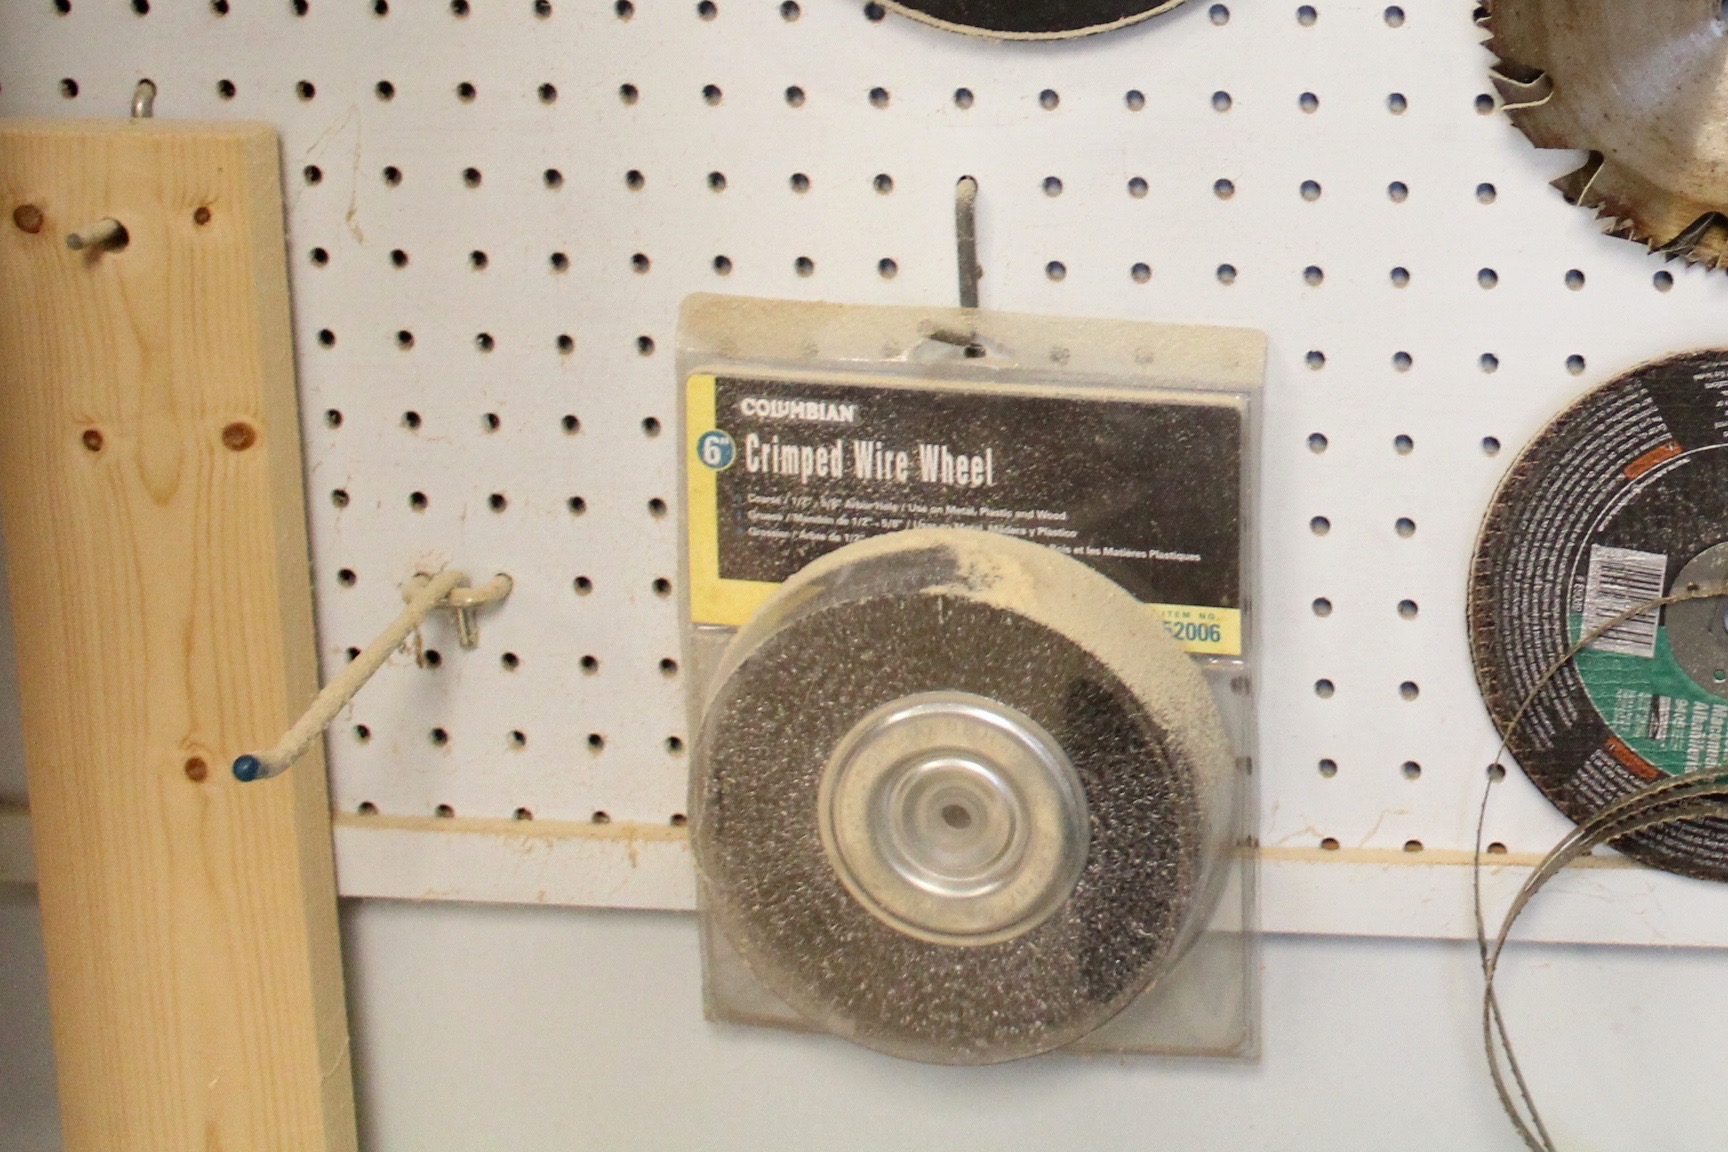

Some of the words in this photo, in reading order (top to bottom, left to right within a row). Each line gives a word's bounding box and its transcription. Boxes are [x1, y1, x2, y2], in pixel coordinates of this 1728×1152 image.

[740, 397, 856, 422] COLUMBIAN
[742, 432, 844, 487] Crimped
[851, 439, 910, 484] Wire
[916, 442, 999, 490] Wheel
[979, 506, 1013, 518] Plastic
[1013, 509, 1035, 520] and
[1036, 509, 1067, 521] Wood
[1073, 545, 1085, 555] et
[1085, 546, 1101, 556] les
[1148, 548, 1202, 565] Plastiques
